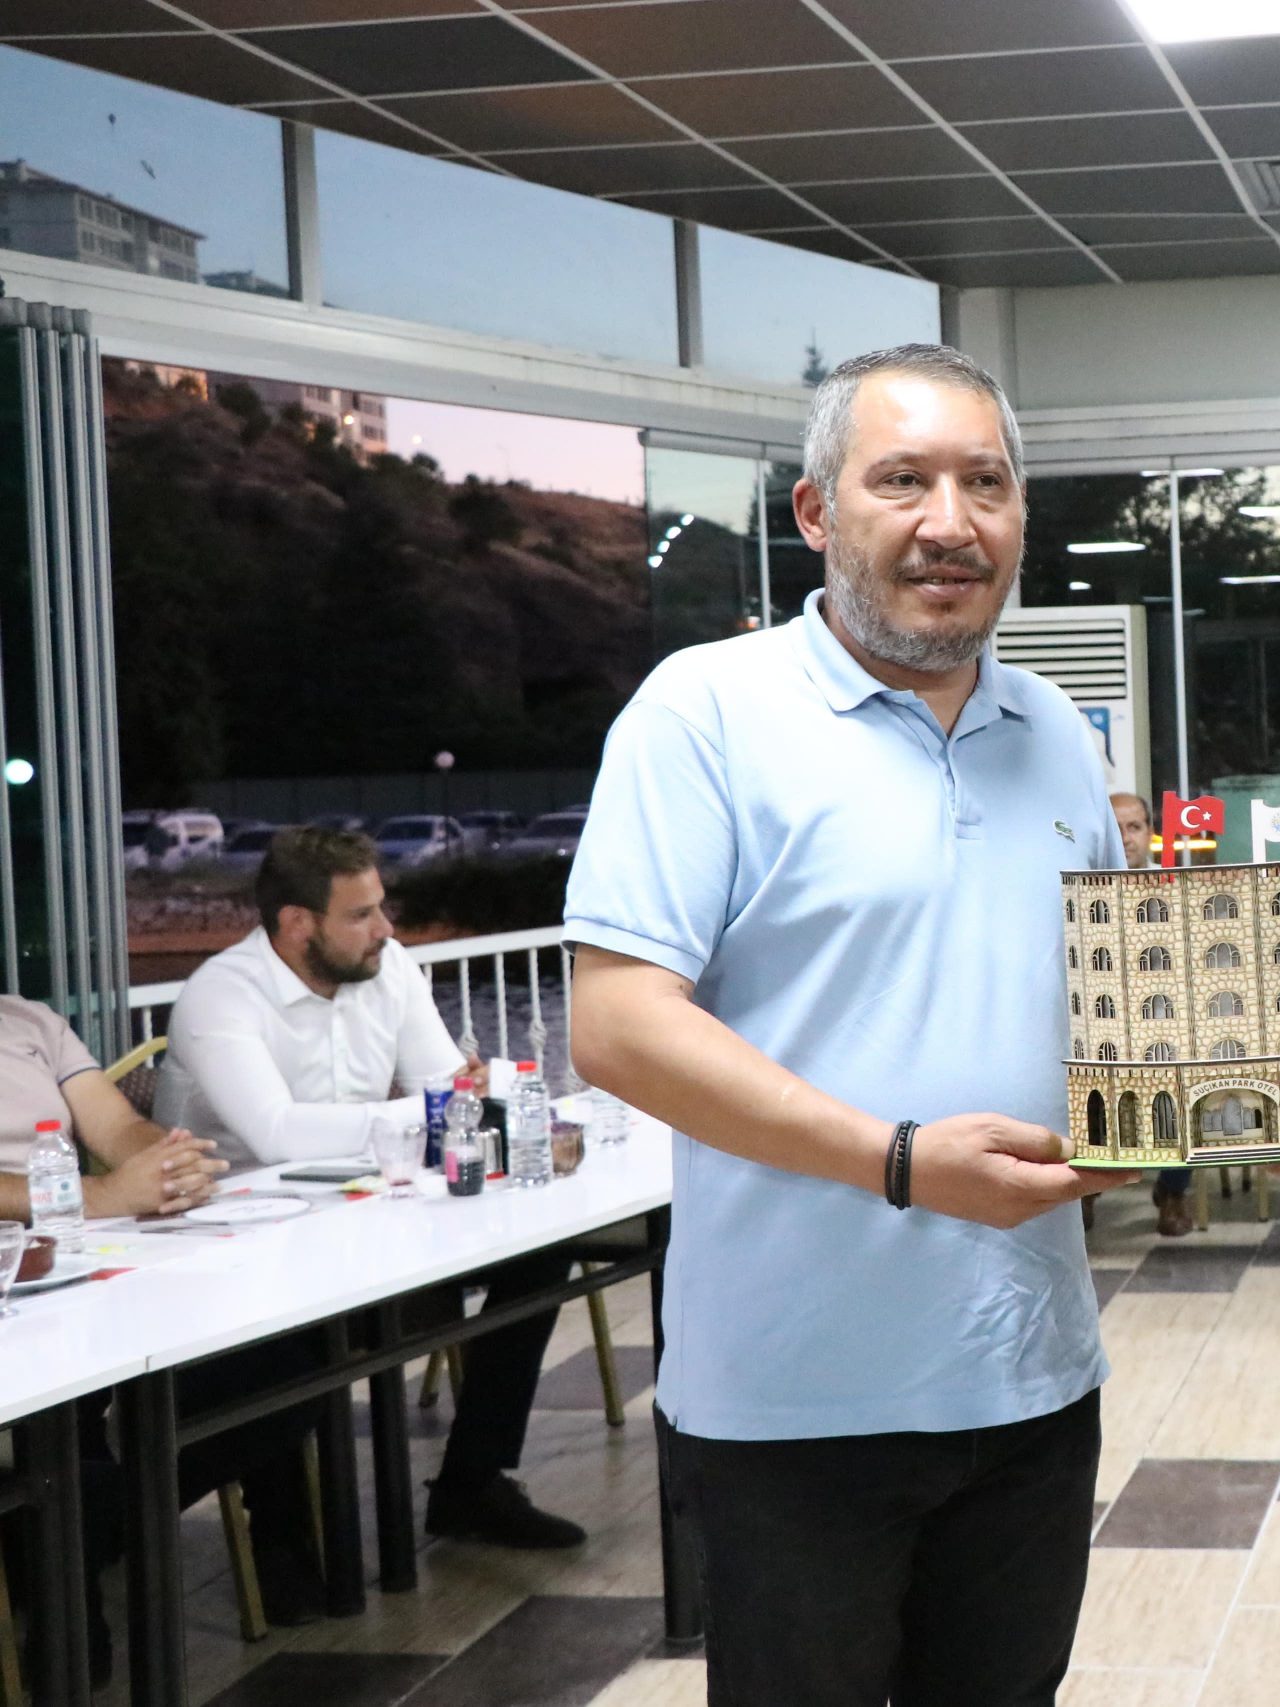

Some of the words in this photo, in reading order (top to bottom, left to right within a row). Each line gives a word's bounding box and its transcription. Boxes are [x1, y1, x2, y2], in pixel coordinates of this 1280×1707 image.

[1193, 1080, 1230, 1097] SUÇIKAN
[1232, 1079, 1255, 1088] PARK
[1257, 1082, 1277, 1097] OTEL
